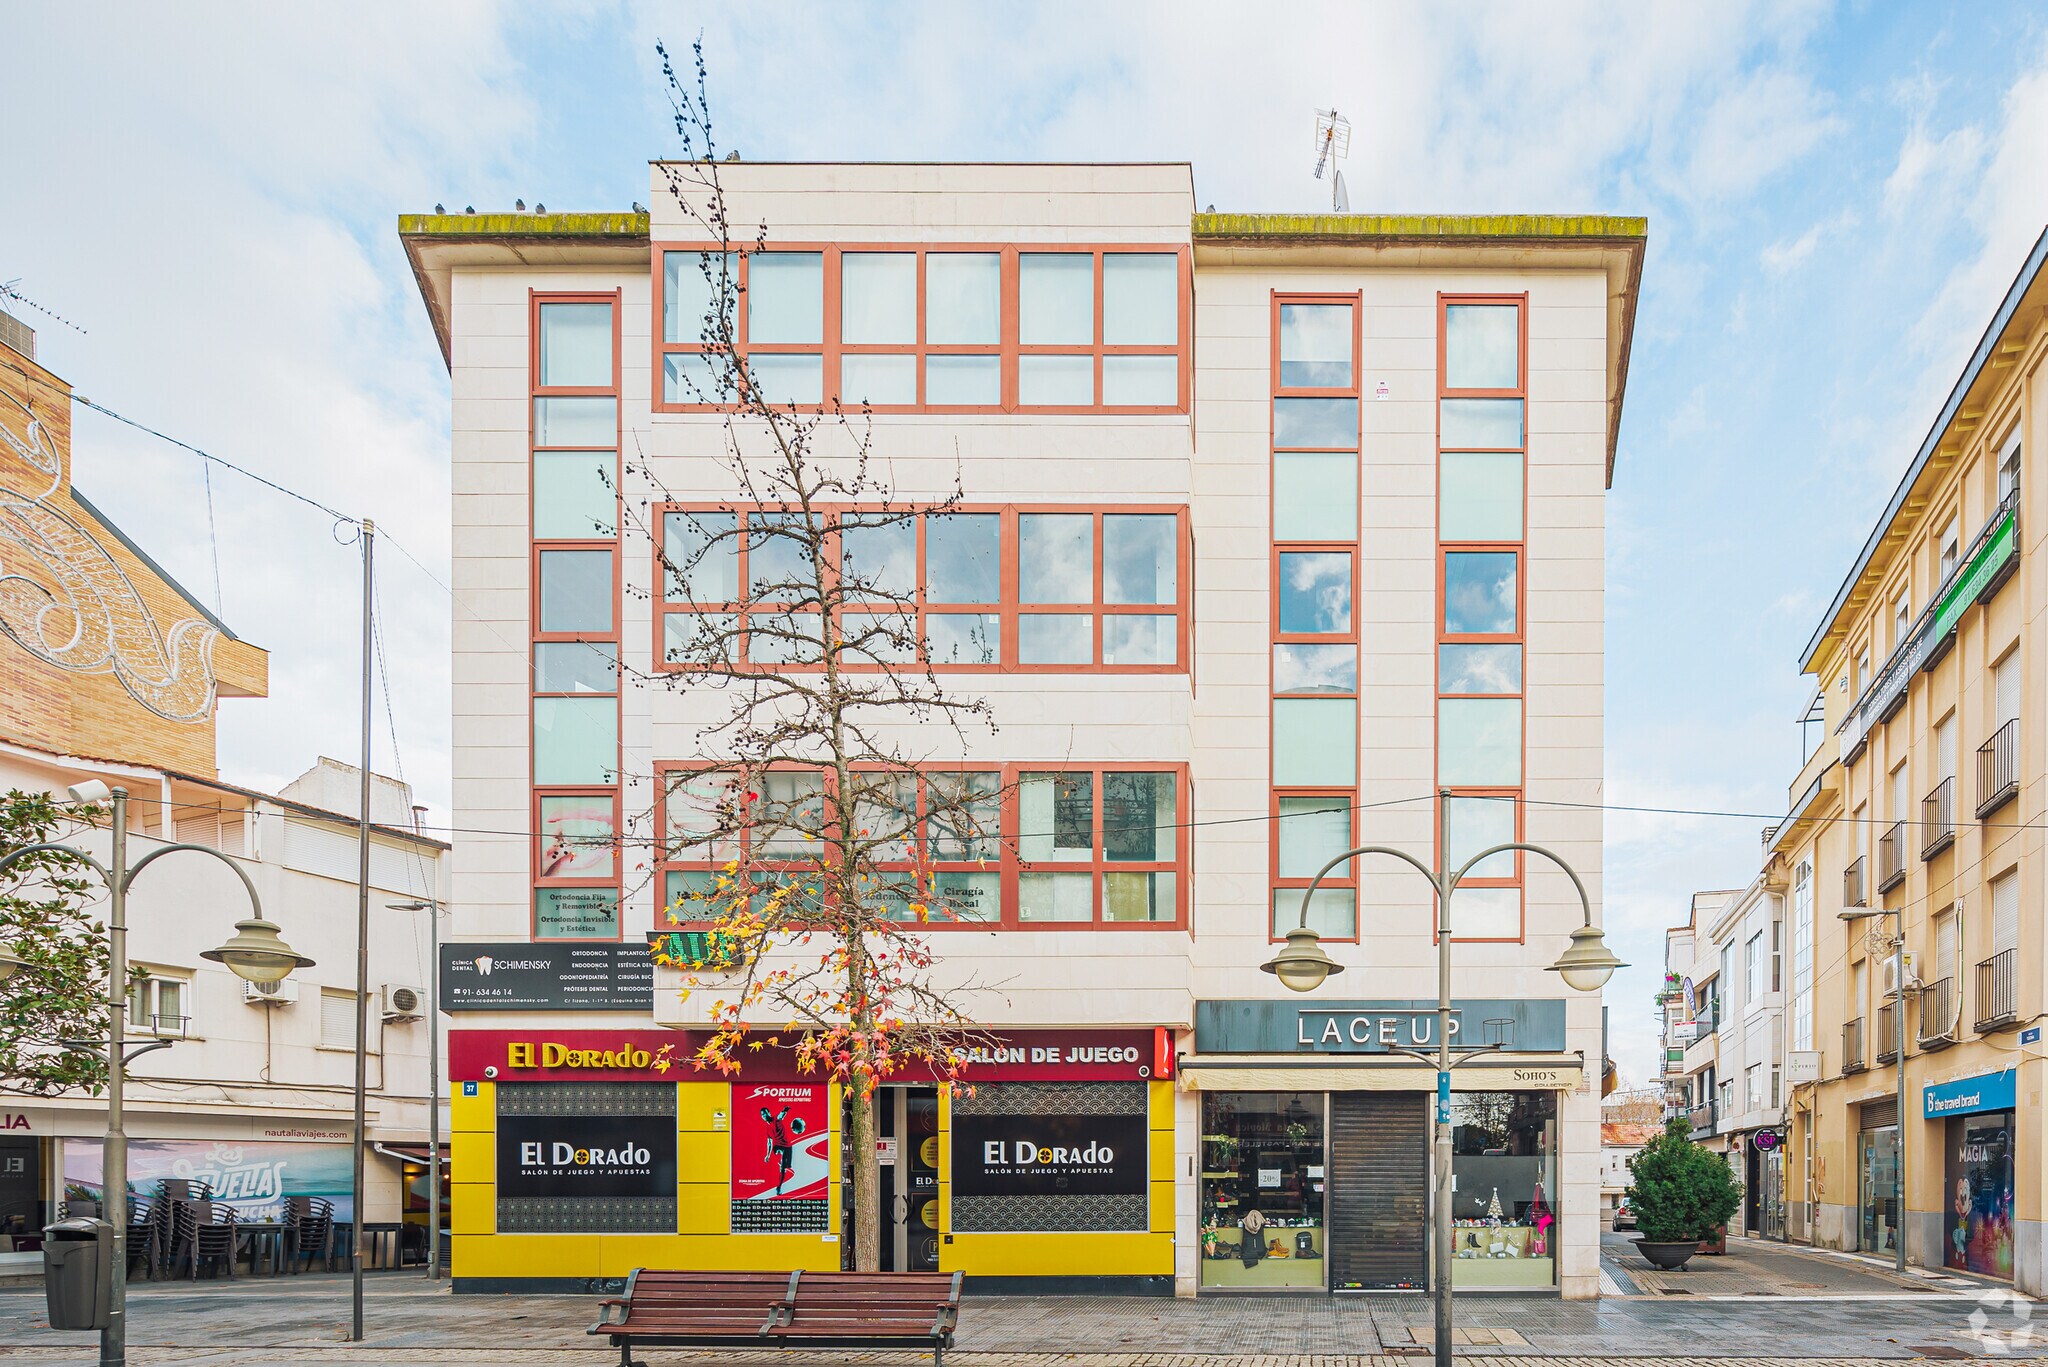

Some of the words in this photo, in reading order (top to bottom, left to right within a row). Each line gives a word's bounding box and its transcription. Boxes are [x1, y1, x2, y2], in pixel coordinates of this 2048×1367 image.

[1946, 606, 1958, 628] FAX
[1963, 590, 1971, 606] 91
[1972, 577, 1982, 596] 634
[1916, 636, 1924, 650] DE
[592, 894, 606, 902] Fija
[944, 887, 984, 897] Cirugía
[494, 960, 552, 970] SCHIMENSKY
[1298, 1017, 1398, 1044] LACE
[1031, 1047, 1060, 1063] DE
[1066, 1046, 1140, 1063] JUEGO
[466, 1084, 474, 1092] 37
[745, 1085, 812, 1100] SPORTIUM
[1935, 1099, 1944, 1112] the
[1944, 1094, 1960, 1110] travel
[1961, 1091, 1980, 1108] brand
[264, 1128, 348, 1140] nautaliaviajes.com
[1758, 1135, 1776, 1144] KSP
[1959, 1145, 1988, 1162] MAGIA
